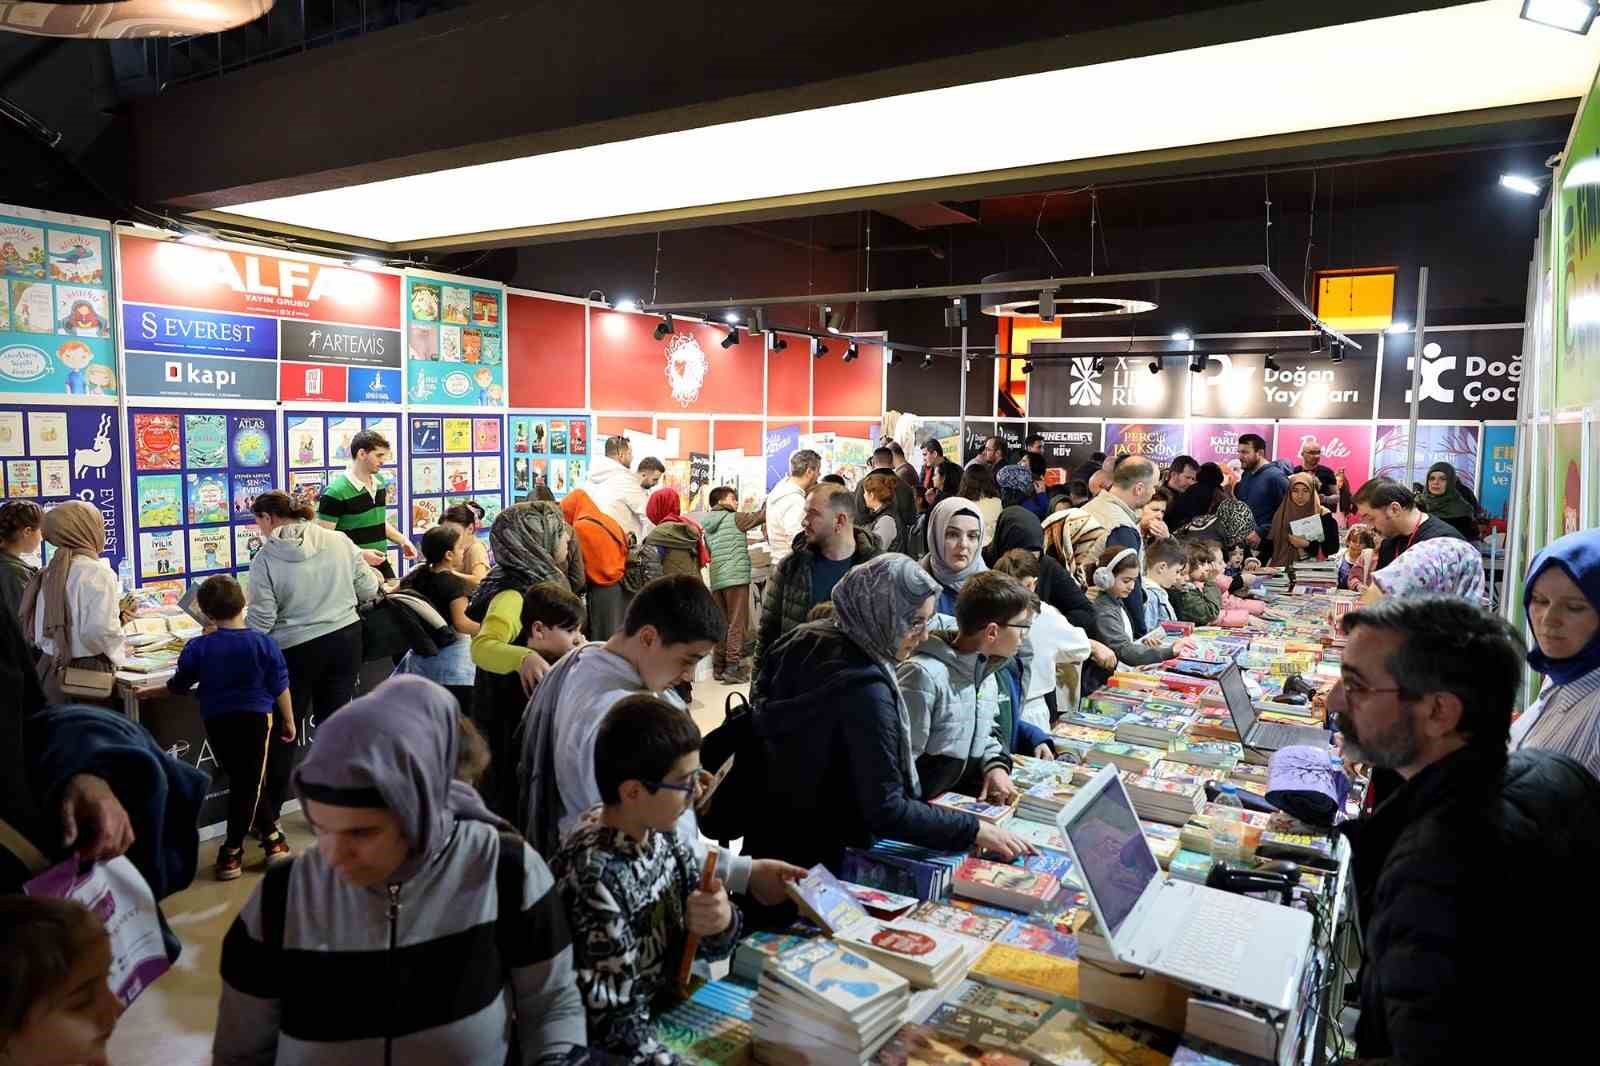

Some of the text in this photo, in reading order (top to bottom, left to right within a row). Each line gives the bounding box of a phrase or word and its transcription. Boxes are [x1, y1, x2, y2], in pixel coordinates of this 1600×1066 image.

[194, 249, 355, 304] ALFA
[245, 294, 274, 304] YAYIN
[188, 362, 236, 389] kapı
[1264, 366, 1335, 387] Doğan
[1263, 386, 1359, 406] Yayarı
[239, 420, 265, 430] ATLAS
[1053, 445, 1072, 457] KÖY
[1114, 442, 1177, 457] JACKSON
[100, 487, 117, 555] EVEREST
